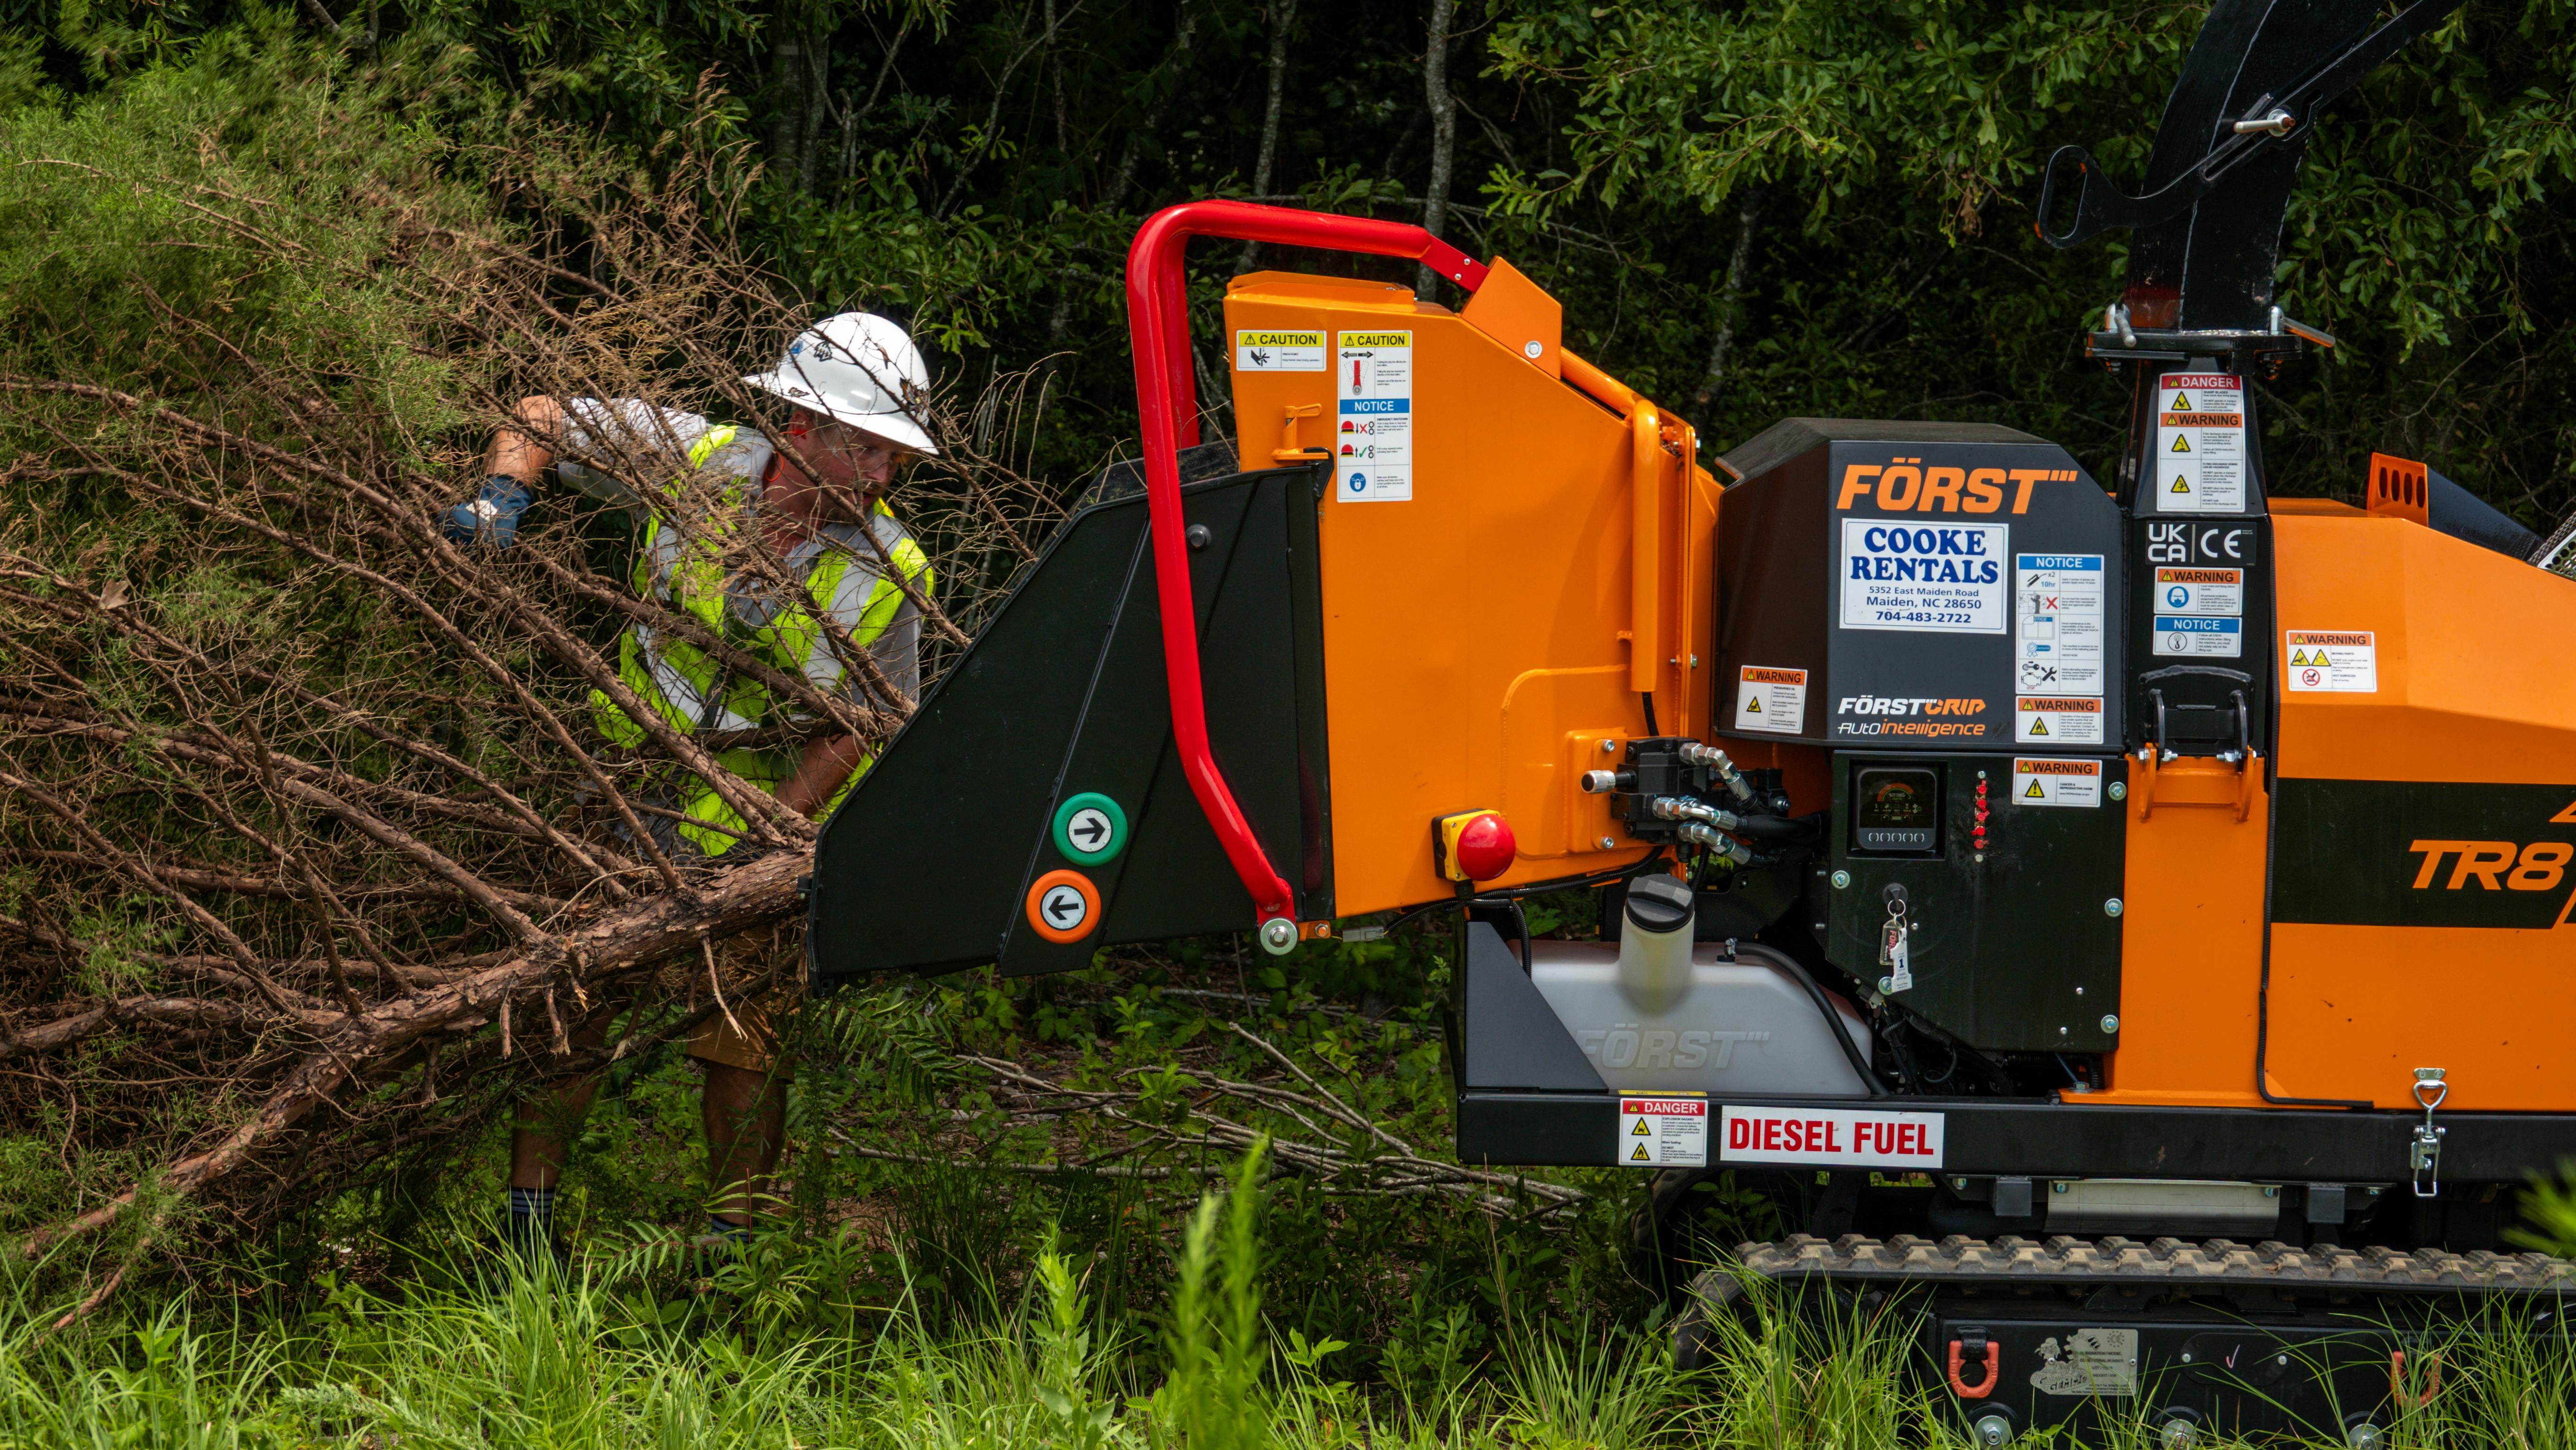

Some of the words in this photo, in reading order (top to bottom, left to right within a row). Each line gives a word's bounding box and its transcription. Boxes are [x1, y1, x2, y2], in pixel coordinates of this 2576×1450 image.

[1260, 335, 1317, 345] CAUTION
[1358, 336, 1404, 345] CAUTION
[2182, 377, 2234, 387] DANGER
[1354, 401, 1394, 411] NOTICE
[2179, 415, 2238, 426] WARNING
[1836, 458, 2078, 514] FÖRST
[2149, 524, 2186, 542] UK
[1865, 527, 1987, 556] COOKE
[2200, 529, 2242, 558] CE
[2148, 544, 2186, 562] CA
[2036, 557, 2083, 568] NOTICE
[1850, 556, 1998, 584] RENTALS
[2174, 572, 2234, 582] WARNING
[1869, 586, 1892, 595] 5352
[1894, 587, 1914, 595] East
[1916, 587, 1952, 596] Maiden
[1955, 588, 1979, 597] Road
[1867, 596, 1918, 608] Maiden,
[1922, 598, 1940, 608] NC
[1944, 599, 1981, 609] 28650
[1876, 611, 1972, 623] 704-483-2722
[2174, 620, 2220, 630] NOTICE
[2306, 635, 2366, 644] WARNING
[1756, 670, 1801, 683] WARNING
[2035, 700, 2094, 711] WARNING
[2033, 763, 2092, 774] WARNING
[2408, 839, 2574, 891] TR8
[1645, 1102, 1698, 1113] DANGER
[1729, 1118, 1841, 1152] DIESEL
[1854, 1121, 1934, 1155] FUEL
